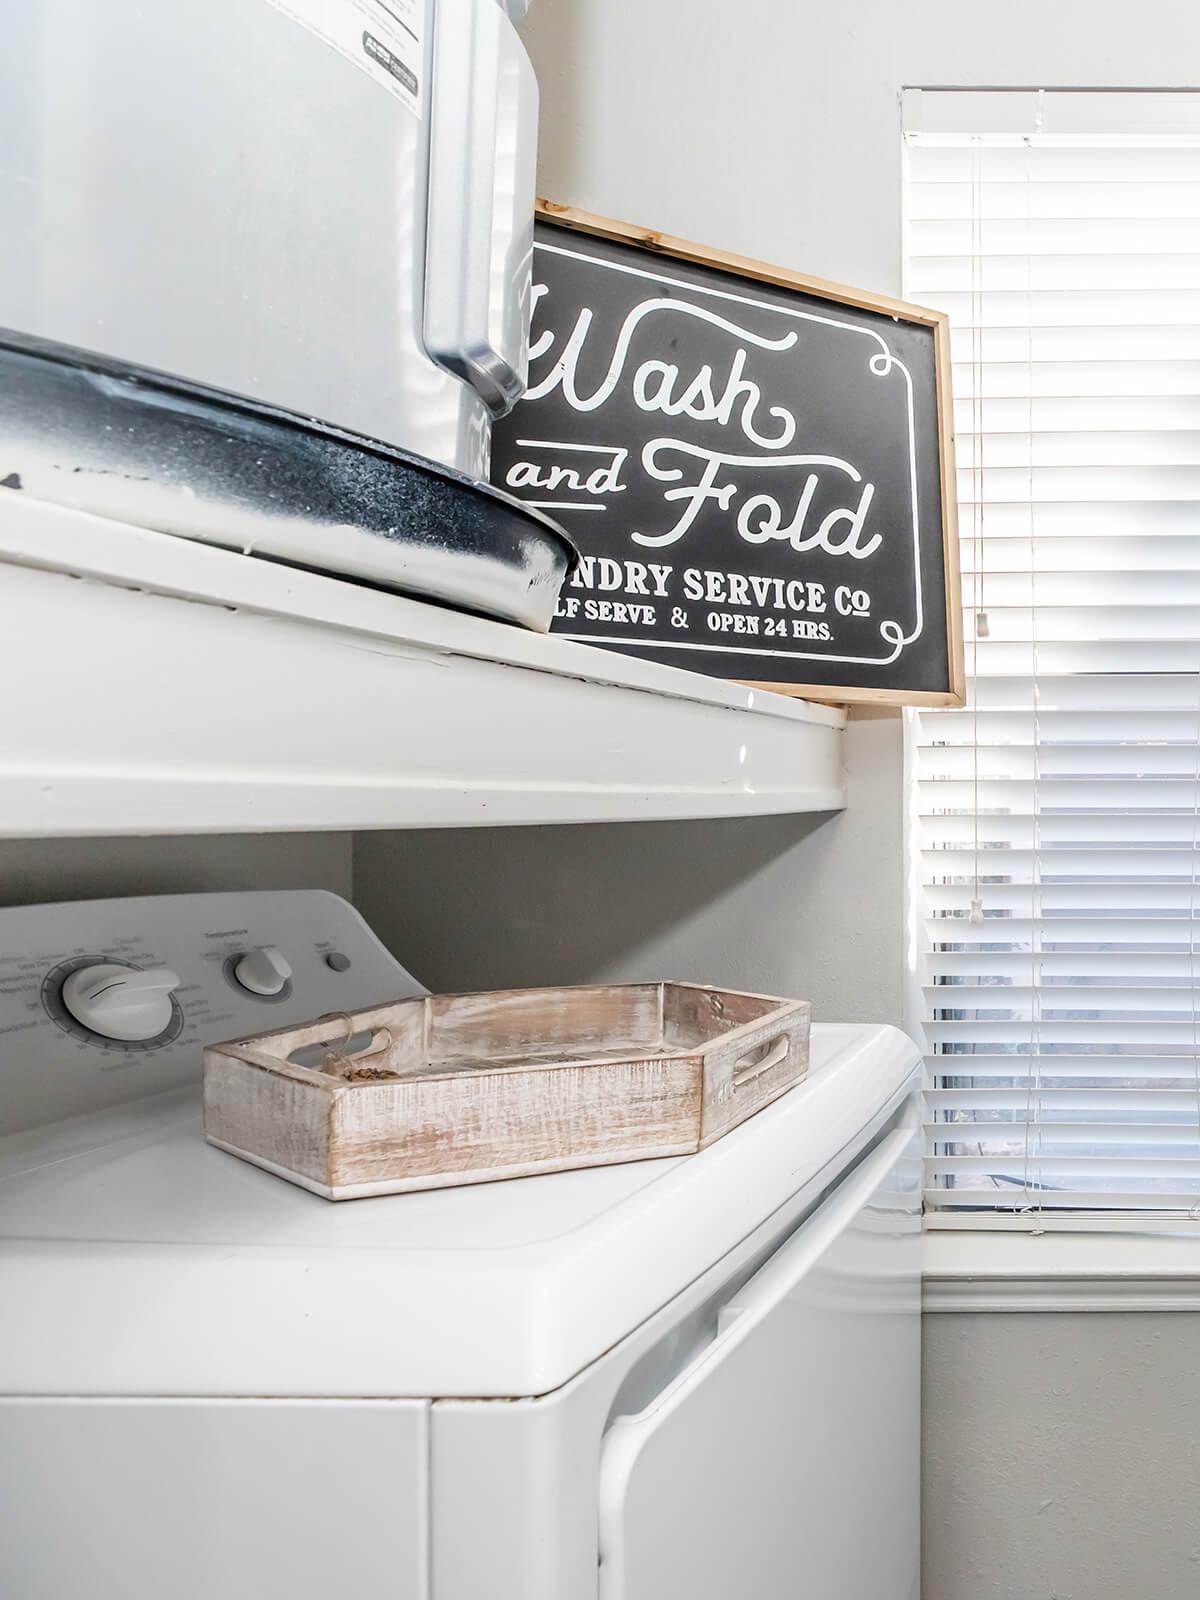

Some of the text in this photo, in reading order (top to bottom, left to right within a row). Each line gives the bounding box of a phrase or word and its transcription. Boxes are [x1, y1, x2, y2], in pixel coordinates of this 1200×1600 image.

[522, 283, 797, 449] Wash
[506, 438, 883, 560] and Fold
[554, 597, 835, 641] LF SERVE & OPEN 24 HRS.
[569, 554, 674, 598] NDRY
[684, 568, 828, 614] SERVICE
